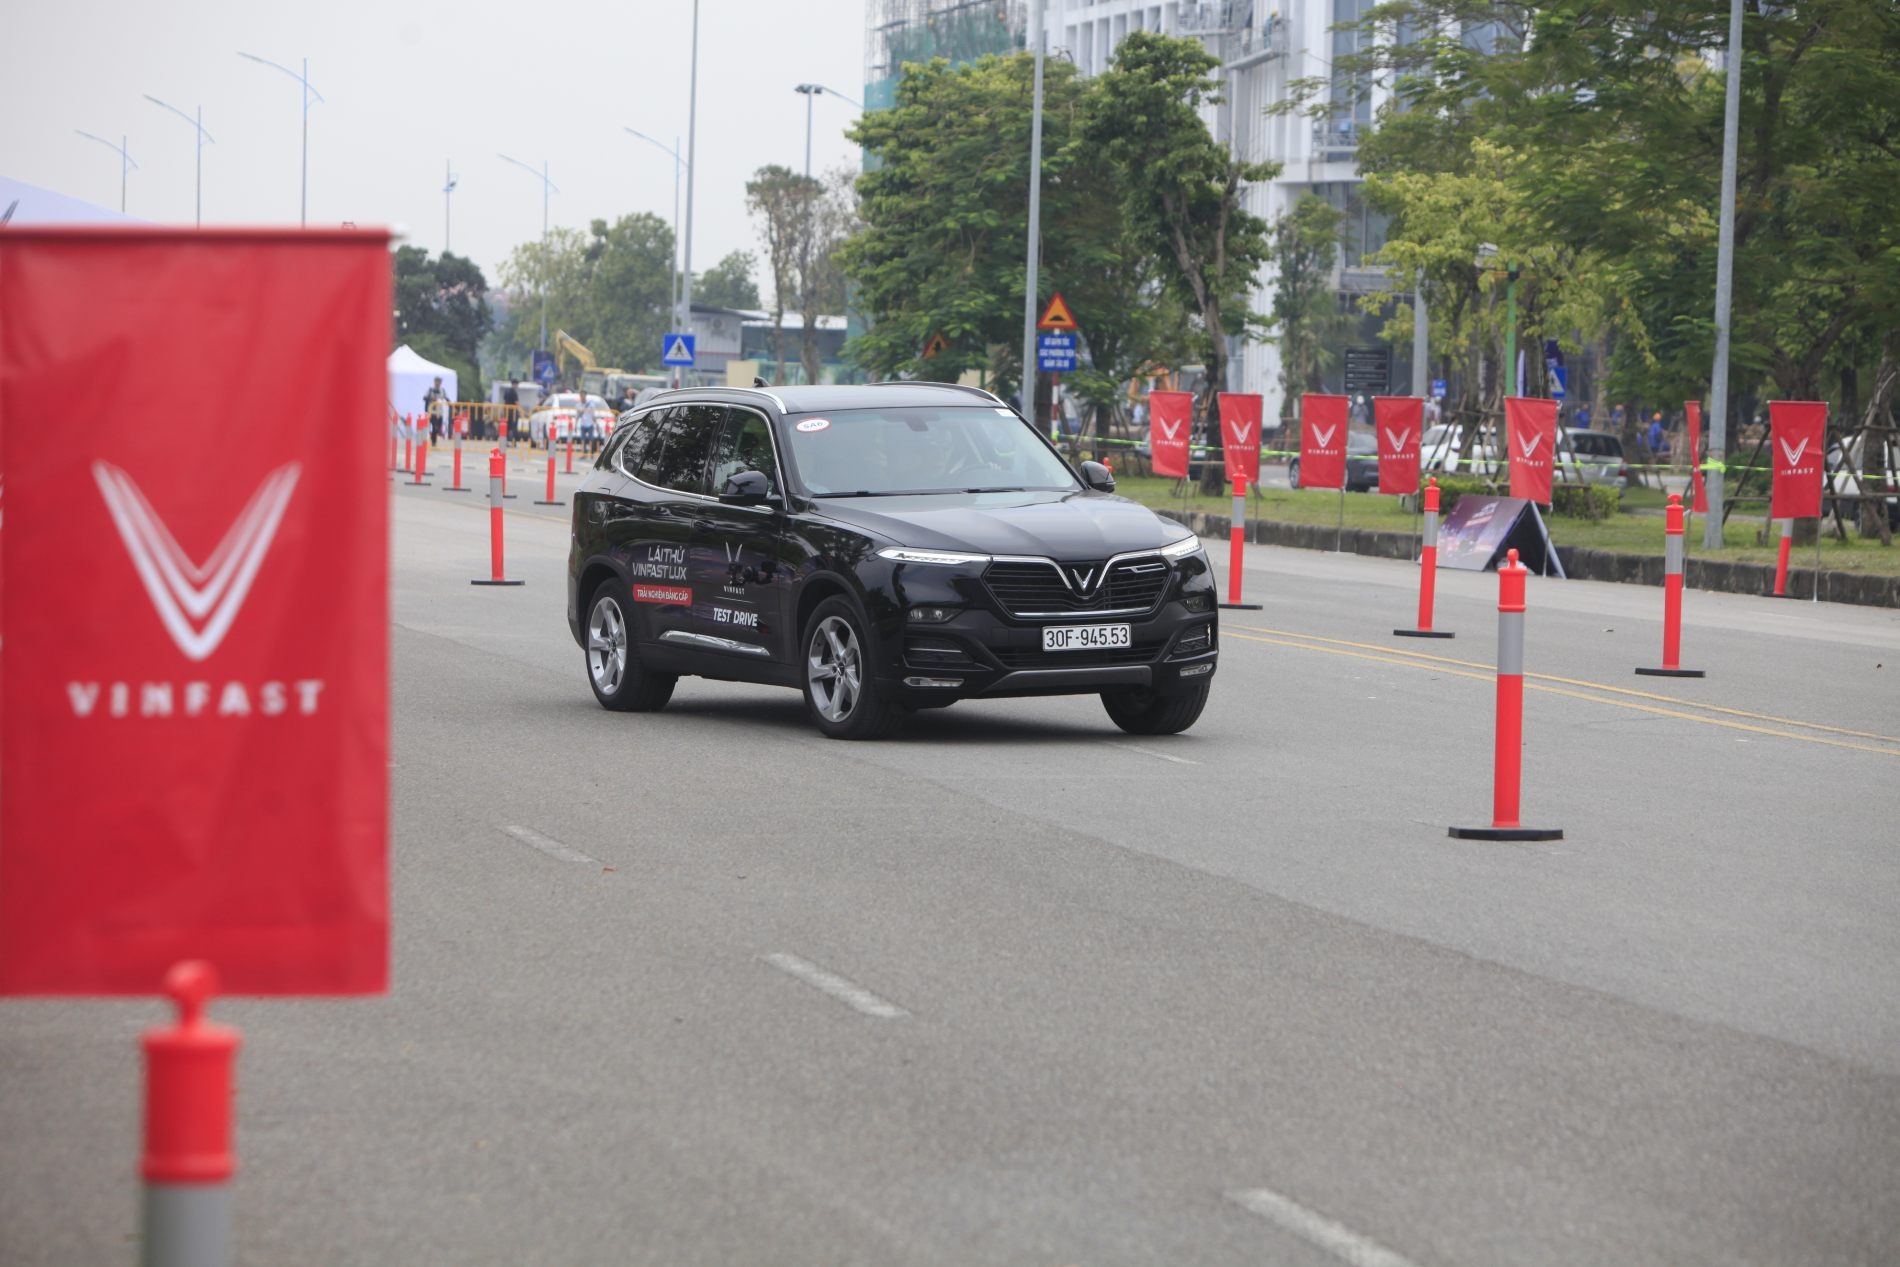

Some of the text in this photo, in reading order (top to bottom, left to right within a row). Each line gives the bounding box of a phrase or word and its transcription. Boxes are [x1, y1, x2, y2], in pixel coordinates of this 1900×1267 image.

[648, 545, 685, 564] LÁI THỬ
[632, 562, 687, 580] VINFAST LUX
[713, 607, 758, 627] TEST DRIVE
[1046, 627, 1128, 647] 30F-945.53
[66, 679, 324, 717] VINFAST
